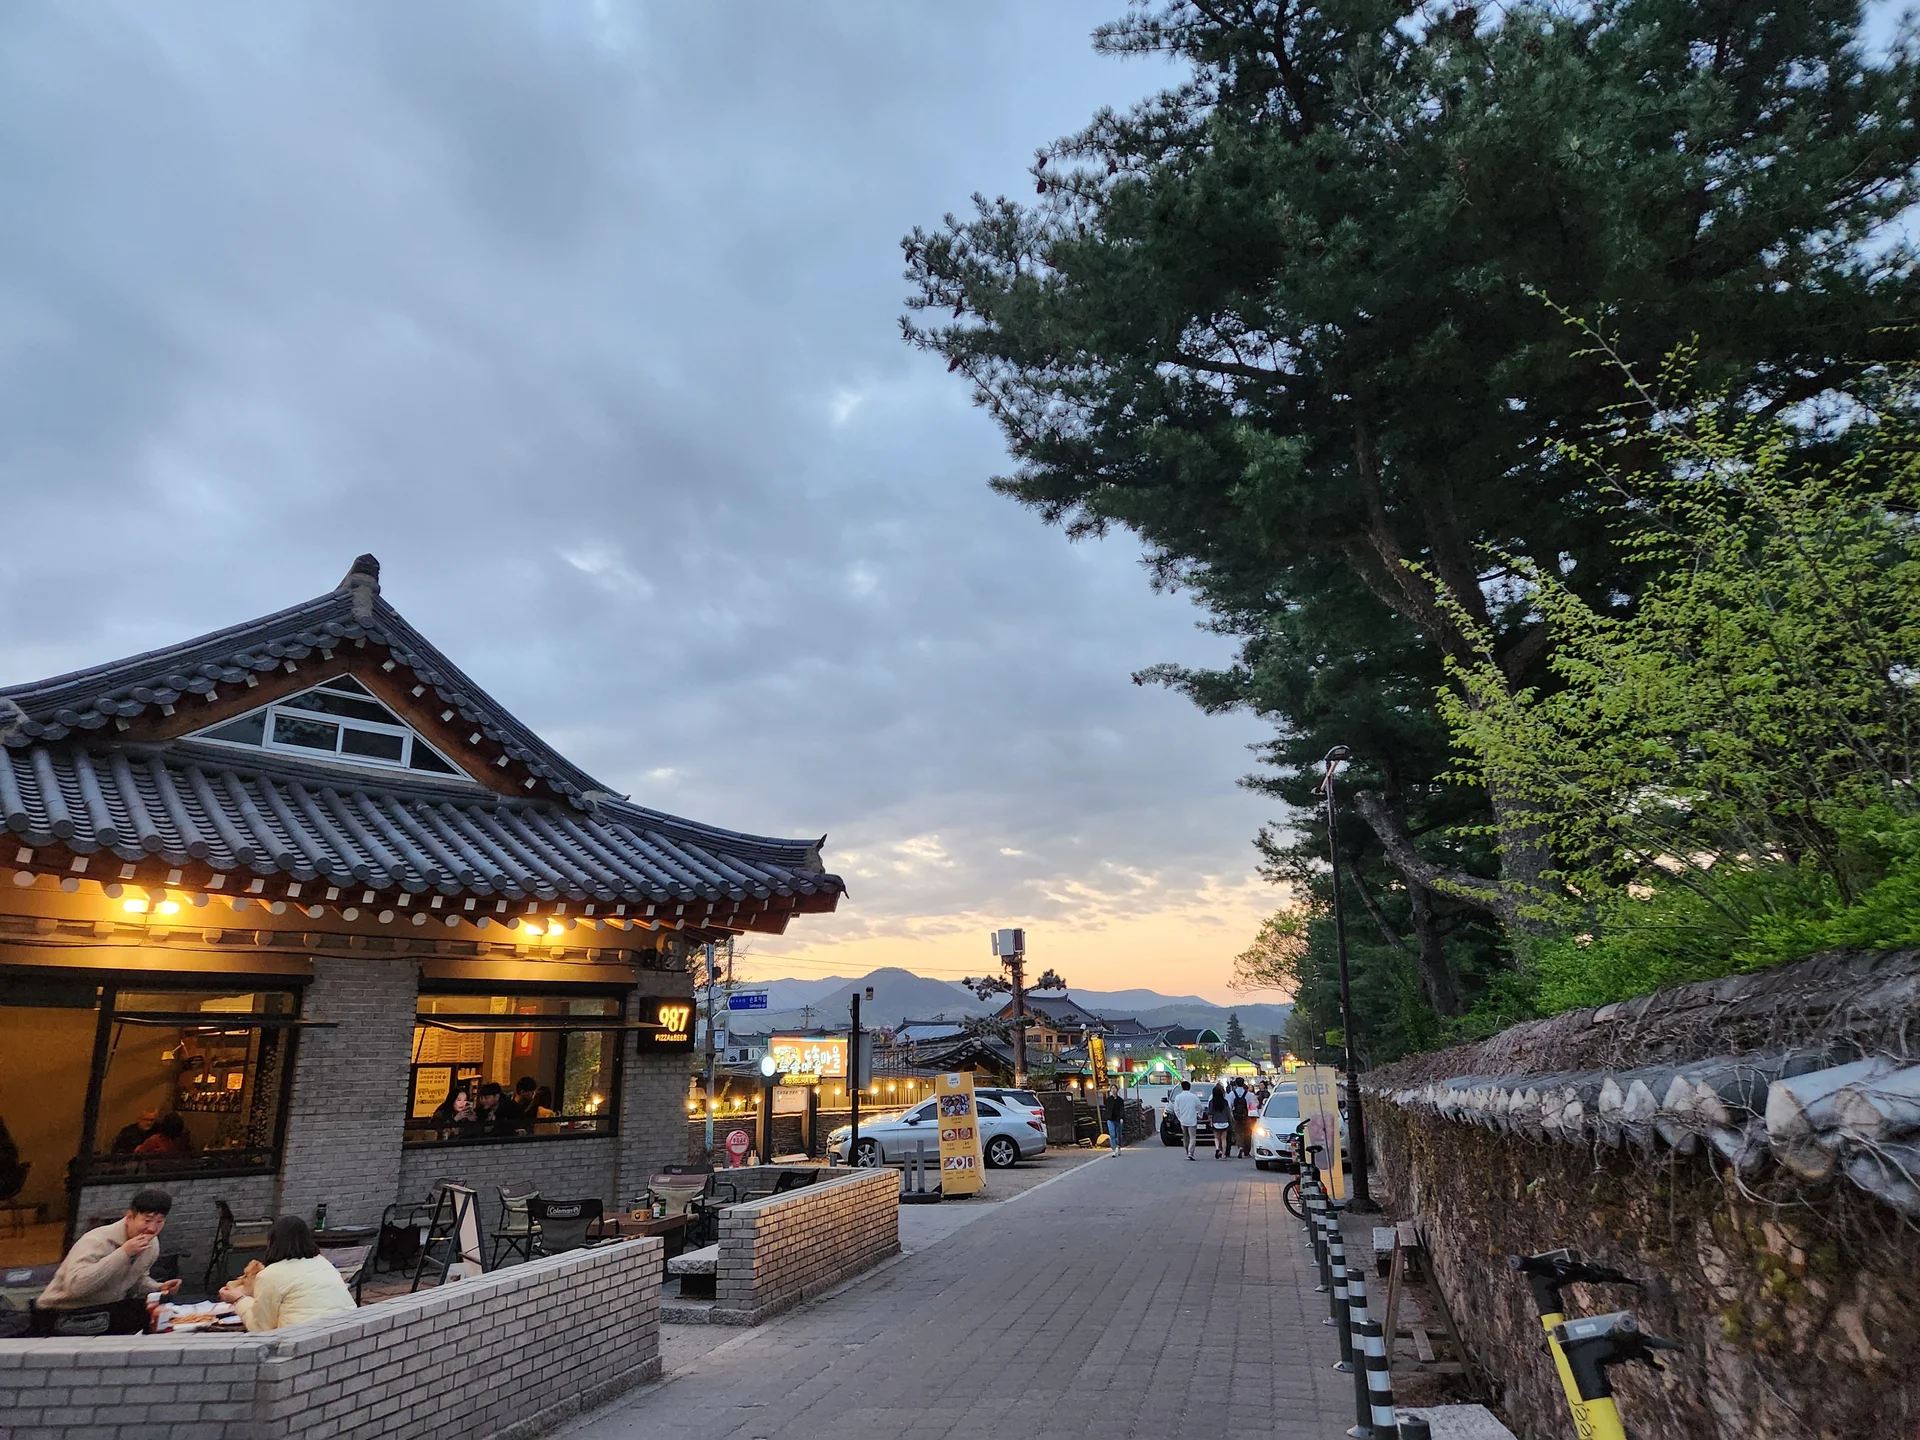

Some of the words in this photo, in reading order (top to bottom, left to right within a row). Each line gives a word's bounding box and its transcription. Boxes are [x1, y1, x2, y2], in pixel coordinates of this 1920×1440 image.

[659, 1006, 690, 1032] 987
[804, 1044, 841, 1069] 도솔마을
[550, 1206, 573, 1215] Coleman
